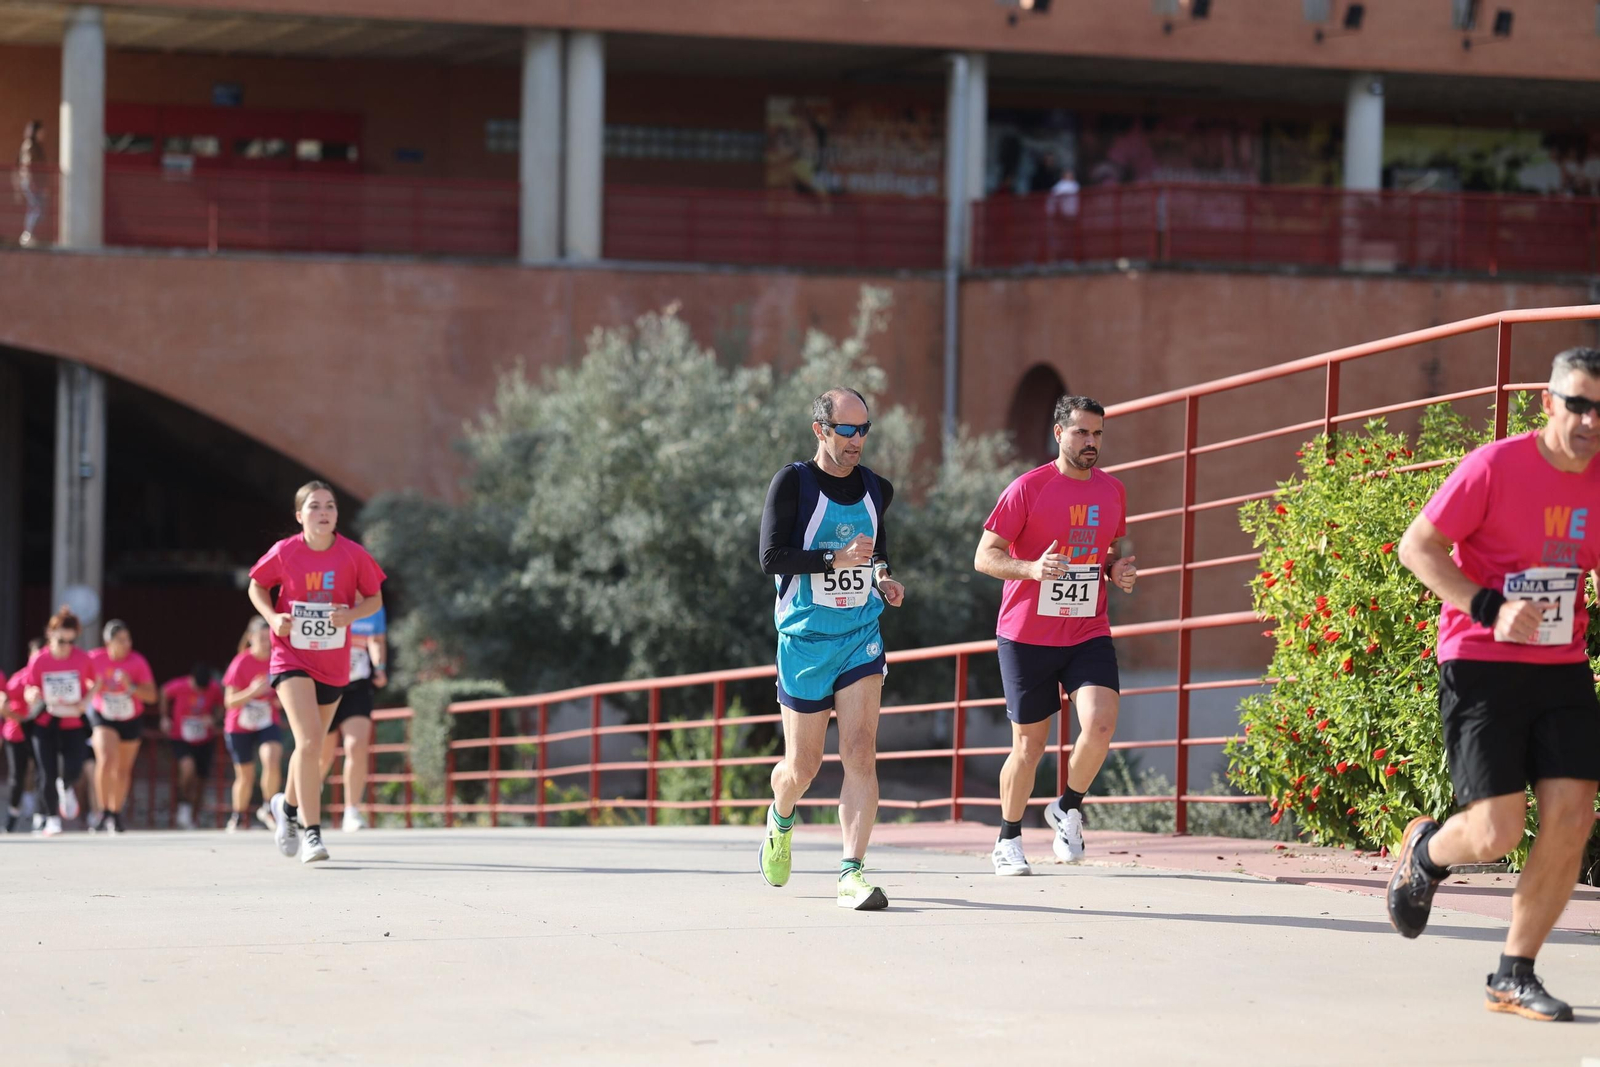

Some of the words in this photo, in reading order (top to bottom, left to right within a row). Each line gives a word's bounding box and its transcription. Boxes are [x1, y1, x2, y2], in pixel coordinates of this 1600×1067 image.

[1069, 504, 1100, 527] WE
[1544, 505, 1588, 540] WE
[305, 570, 335, 591] WE
[823, 569, 864, 592] 565
[1509, 579, 1545, 592] UMA
[1050, 582, 1090, 602] 541
[295, 608, 319, 619] UMA
[301, 620, 337, 637] 685
